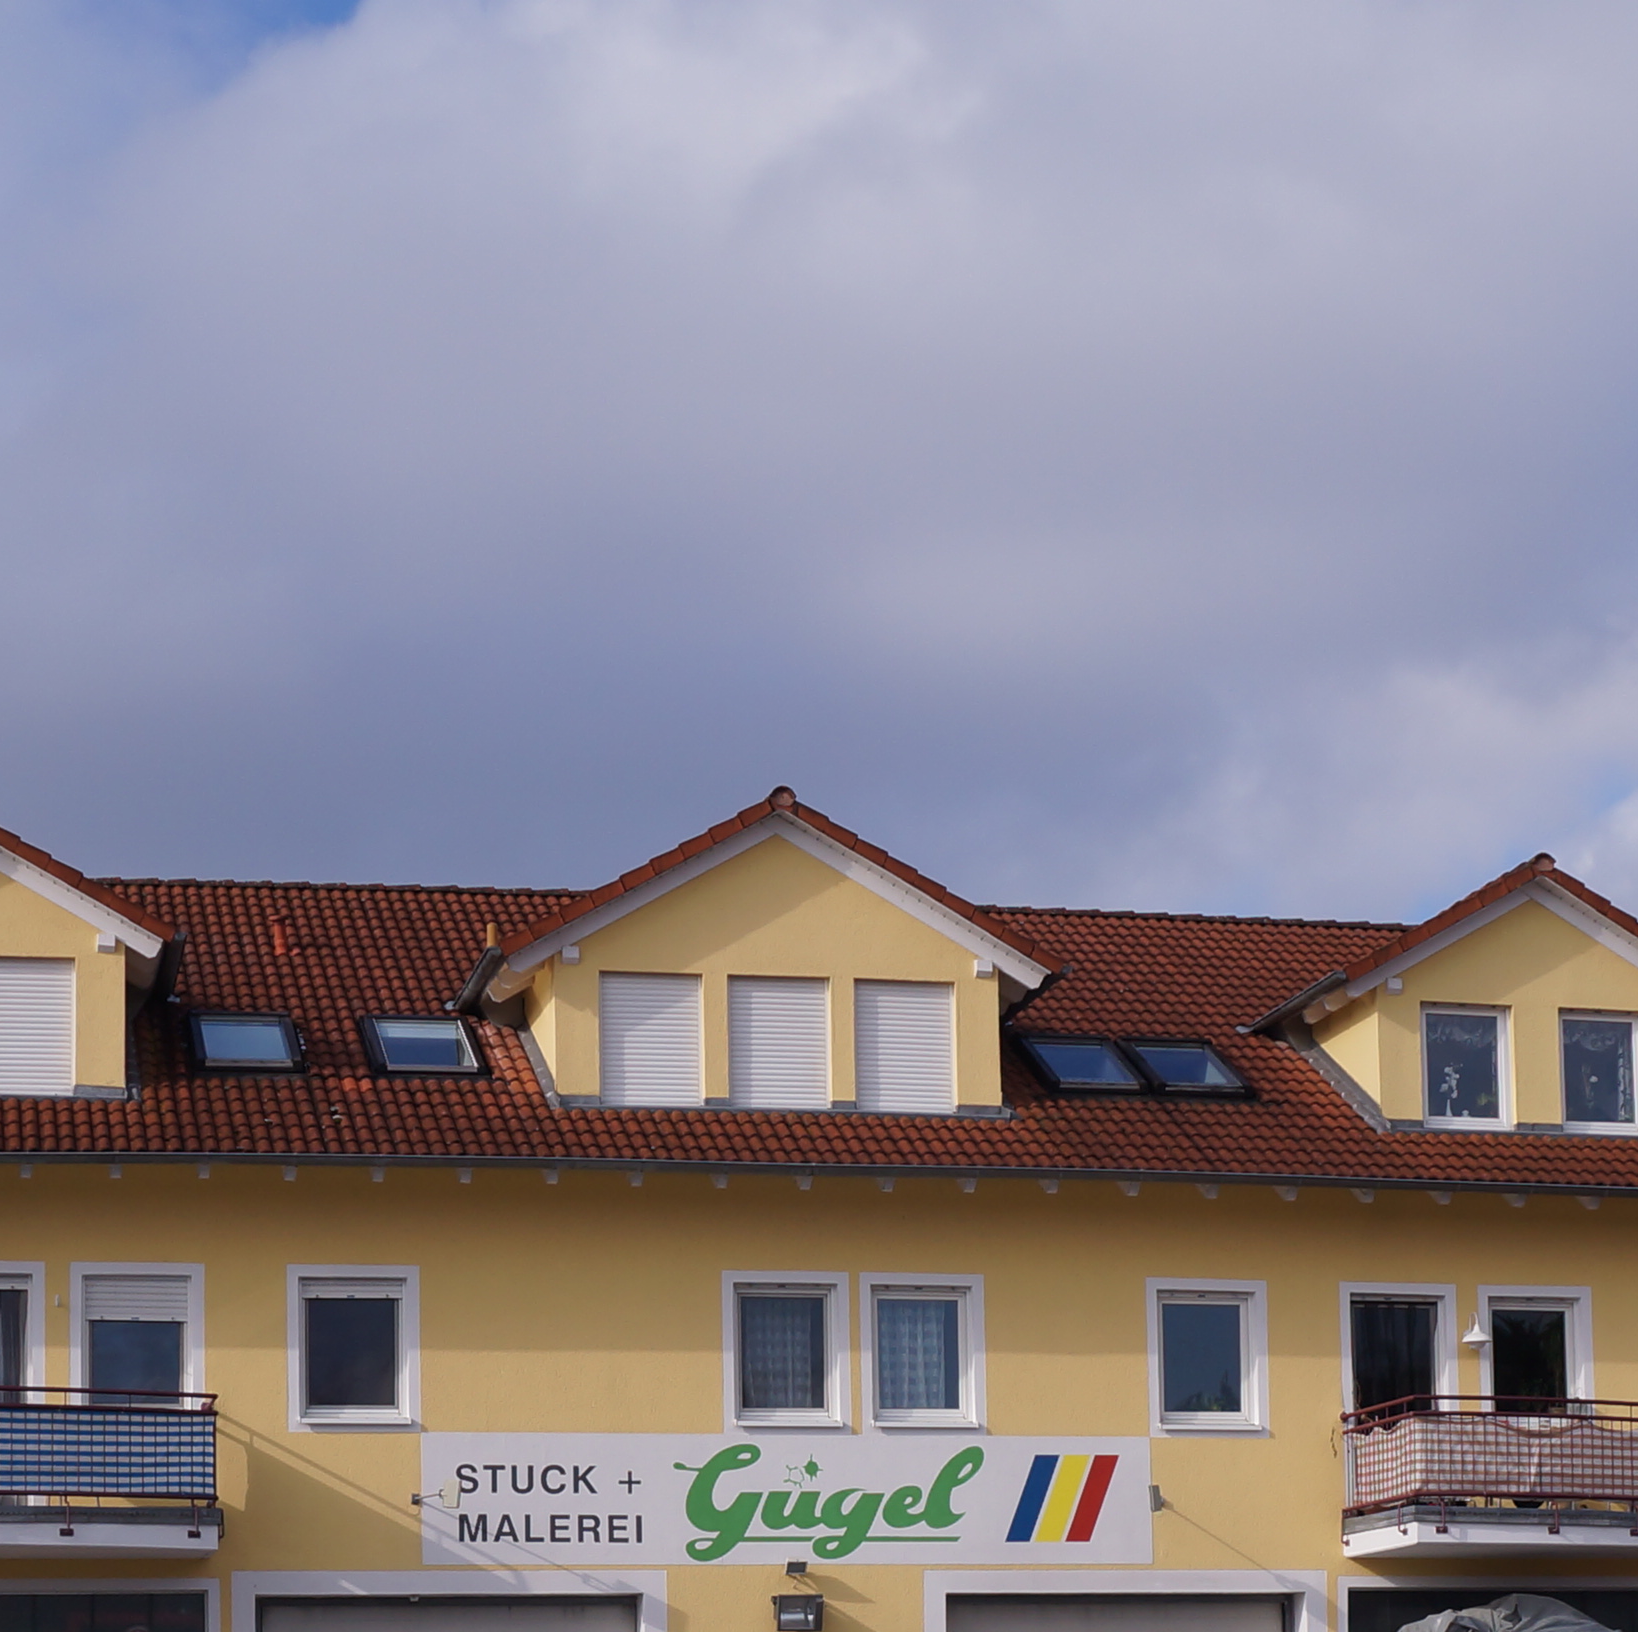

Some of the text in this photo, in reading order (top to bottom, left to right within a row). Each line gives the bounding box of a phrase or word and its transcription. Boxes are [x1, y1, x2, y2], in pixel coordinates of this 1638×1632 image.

[455, 1463, 642, 1495] STUCK +
[458, 1513, 643, 1544] MALEREI
